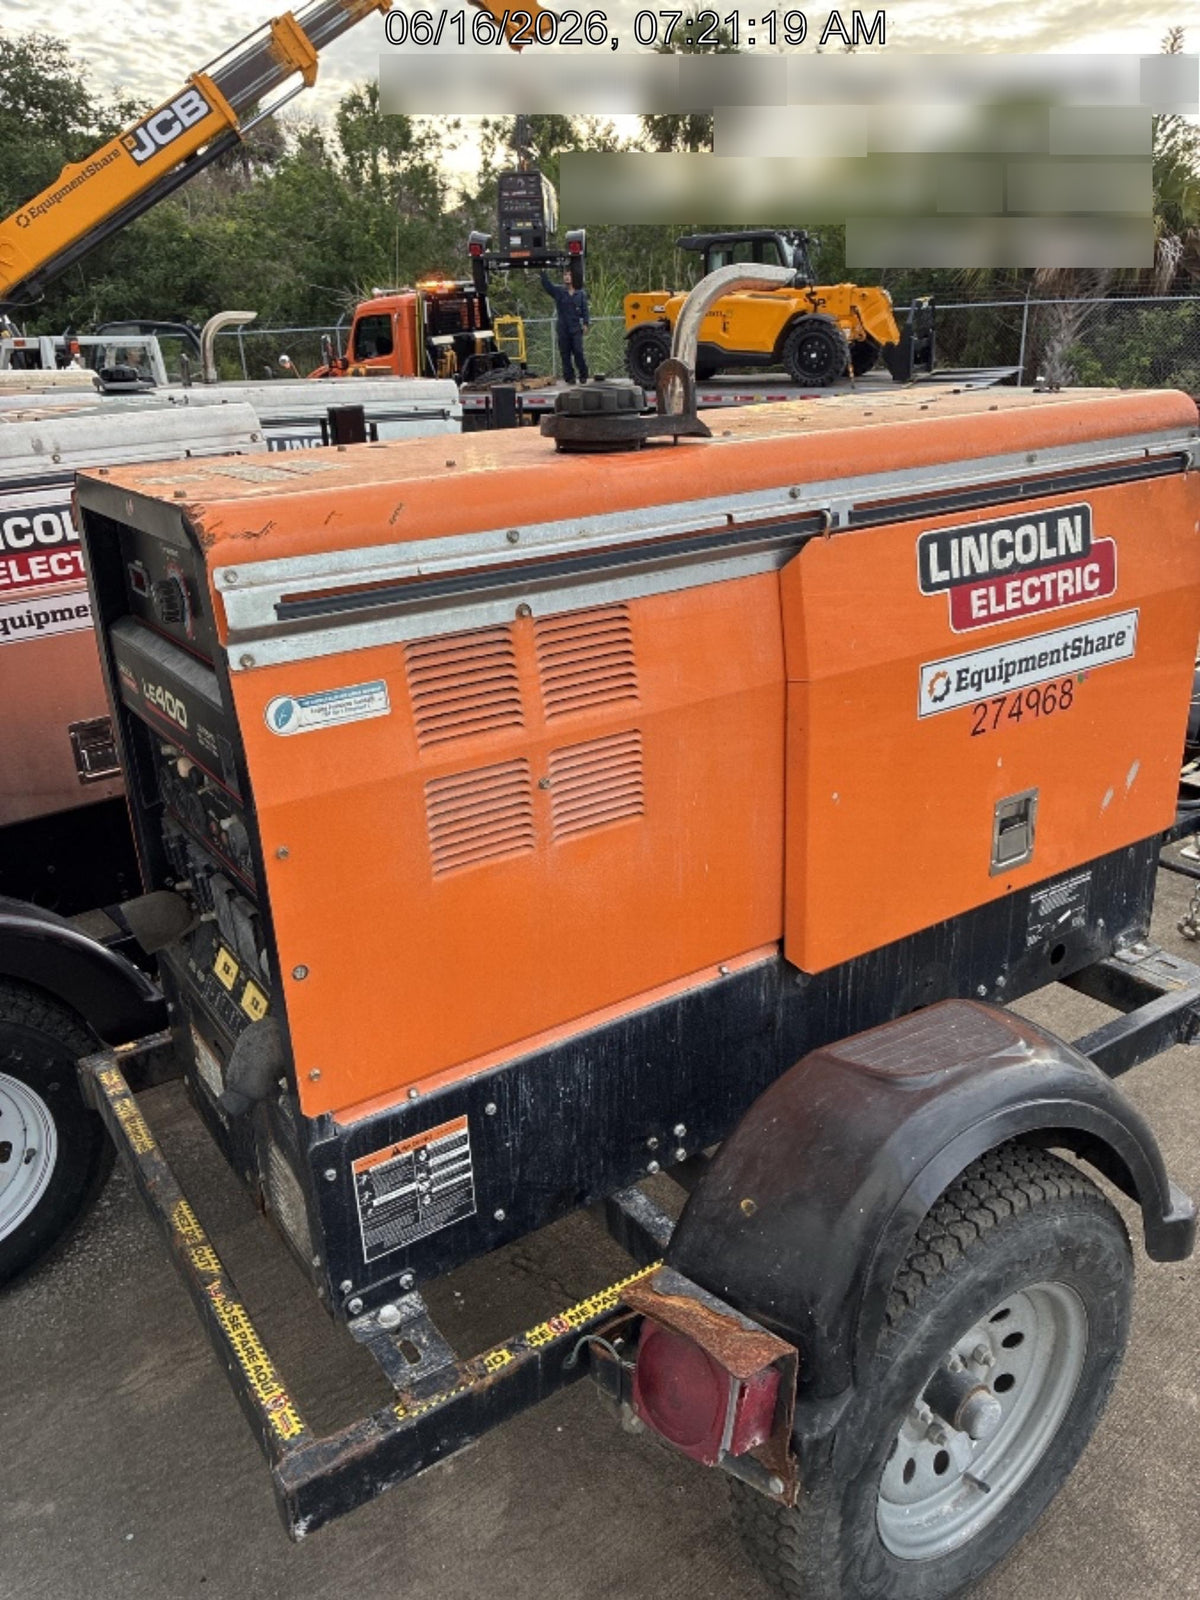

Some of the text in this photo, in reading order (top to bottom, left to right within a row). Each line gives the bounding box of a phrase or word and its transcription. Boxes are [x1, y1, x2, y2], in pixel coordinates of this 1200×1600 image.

[132, 89, 209, 162] JCB
[29, 148, 121, 219] EquipmentShare
[0, 508, 81, 551] COL
[929, 514, 1083, 584] LINCOLN
[0, 603, 94, 635] quipme
[970, 562, 1101, 620] ELECTRIC
[954, 629, 1127, 693] EquipmentShare
[970, 678, 1074, 736] 274968
[227, 1314, 243, 1333] SE
[236, 1330, 260, 1364] PARE
[568, 1305, 590, 1323] NE
